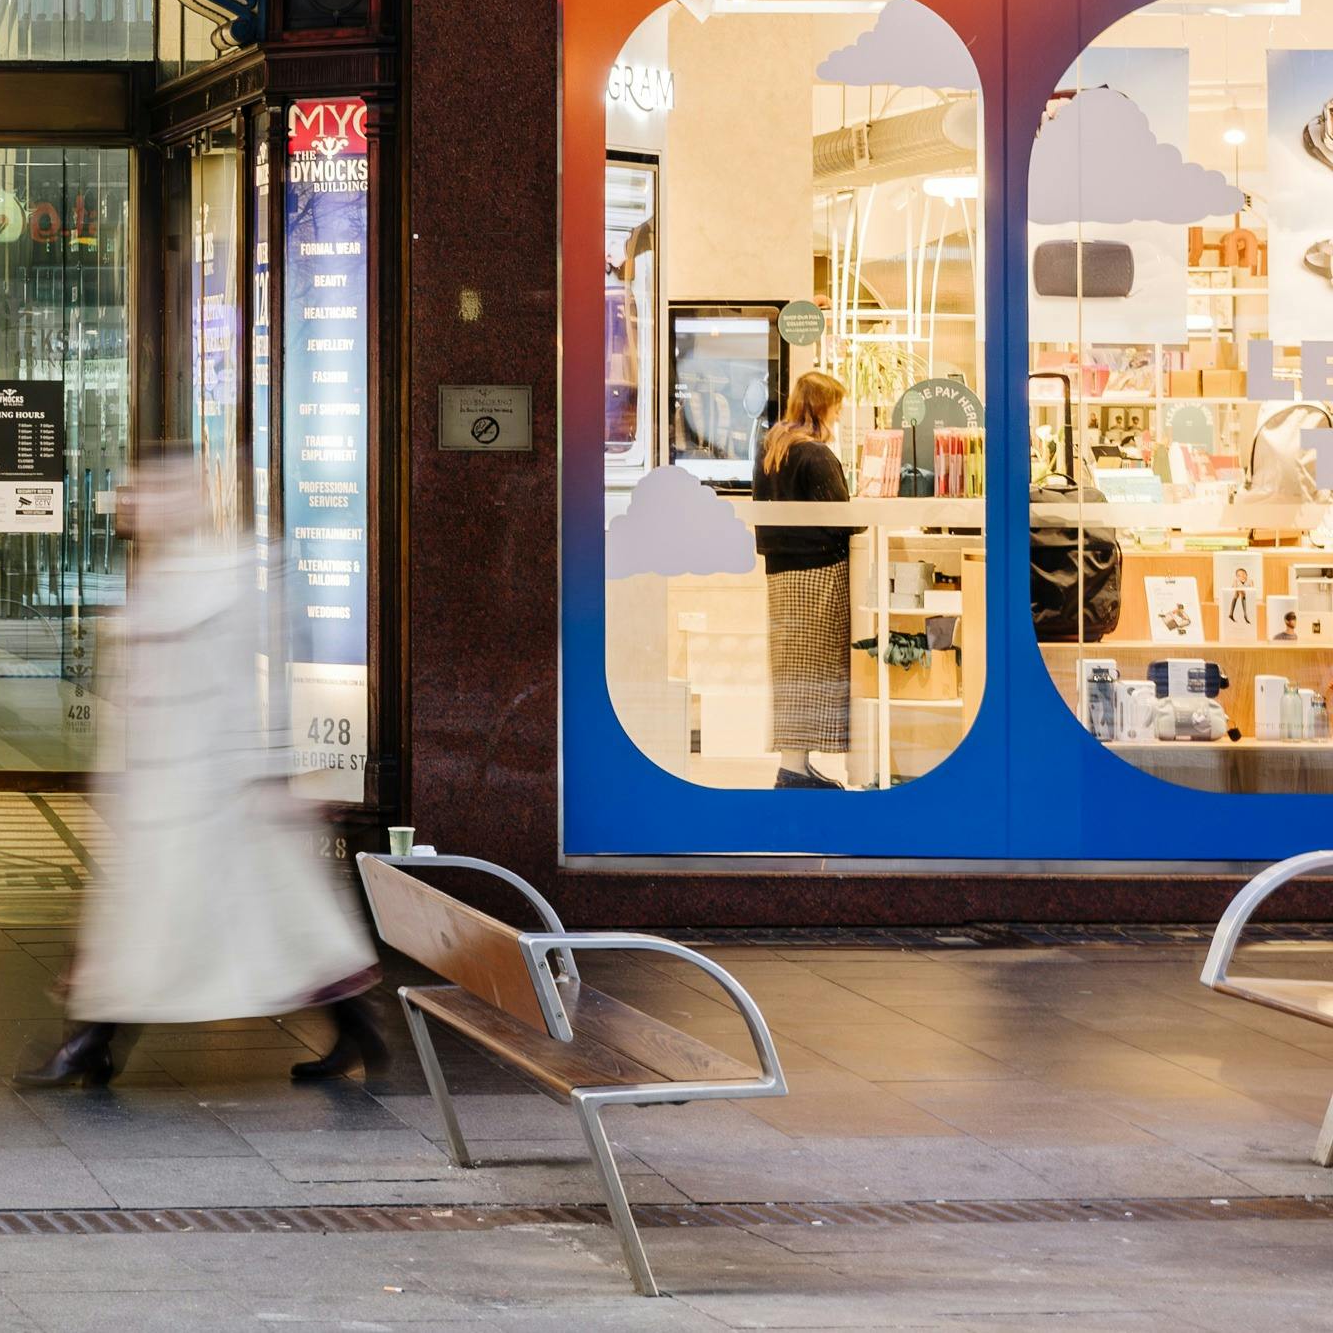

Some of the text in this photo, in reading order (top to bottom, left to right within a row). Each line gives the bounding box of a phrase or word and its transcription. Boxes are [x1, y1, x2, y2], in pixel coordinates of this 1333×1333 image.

[294, 150, 316, 160] THE
[290, 160, 368, 182] DYMOCKS
[313, 181, 368, 193] BUILDING
[300, 242, 361, 255] FORMAL WEAR
[314, 274, 347, 287] BEAUTY
[304, 306, 358, 319] HEALTHCARE
[306, 338, 354, 351] JEWELLERY
[299, 403, 318, 416] GIFT
[935, 386, 959, 399] PAY
[958, 396, 978, 427] HERE
[298, 481, 358, 494] PROFESSIONAL
[309, 495, 349, 508] SERVICES
[295, 527, 362, 541] ENTERTAINMENT
[298, 559, 351, 572] ALTERATIONS
[68, 705, 91, 719] 428
[307, 717, 351, 745] 428
[292, 752, 366, 771] GEORGE ST
